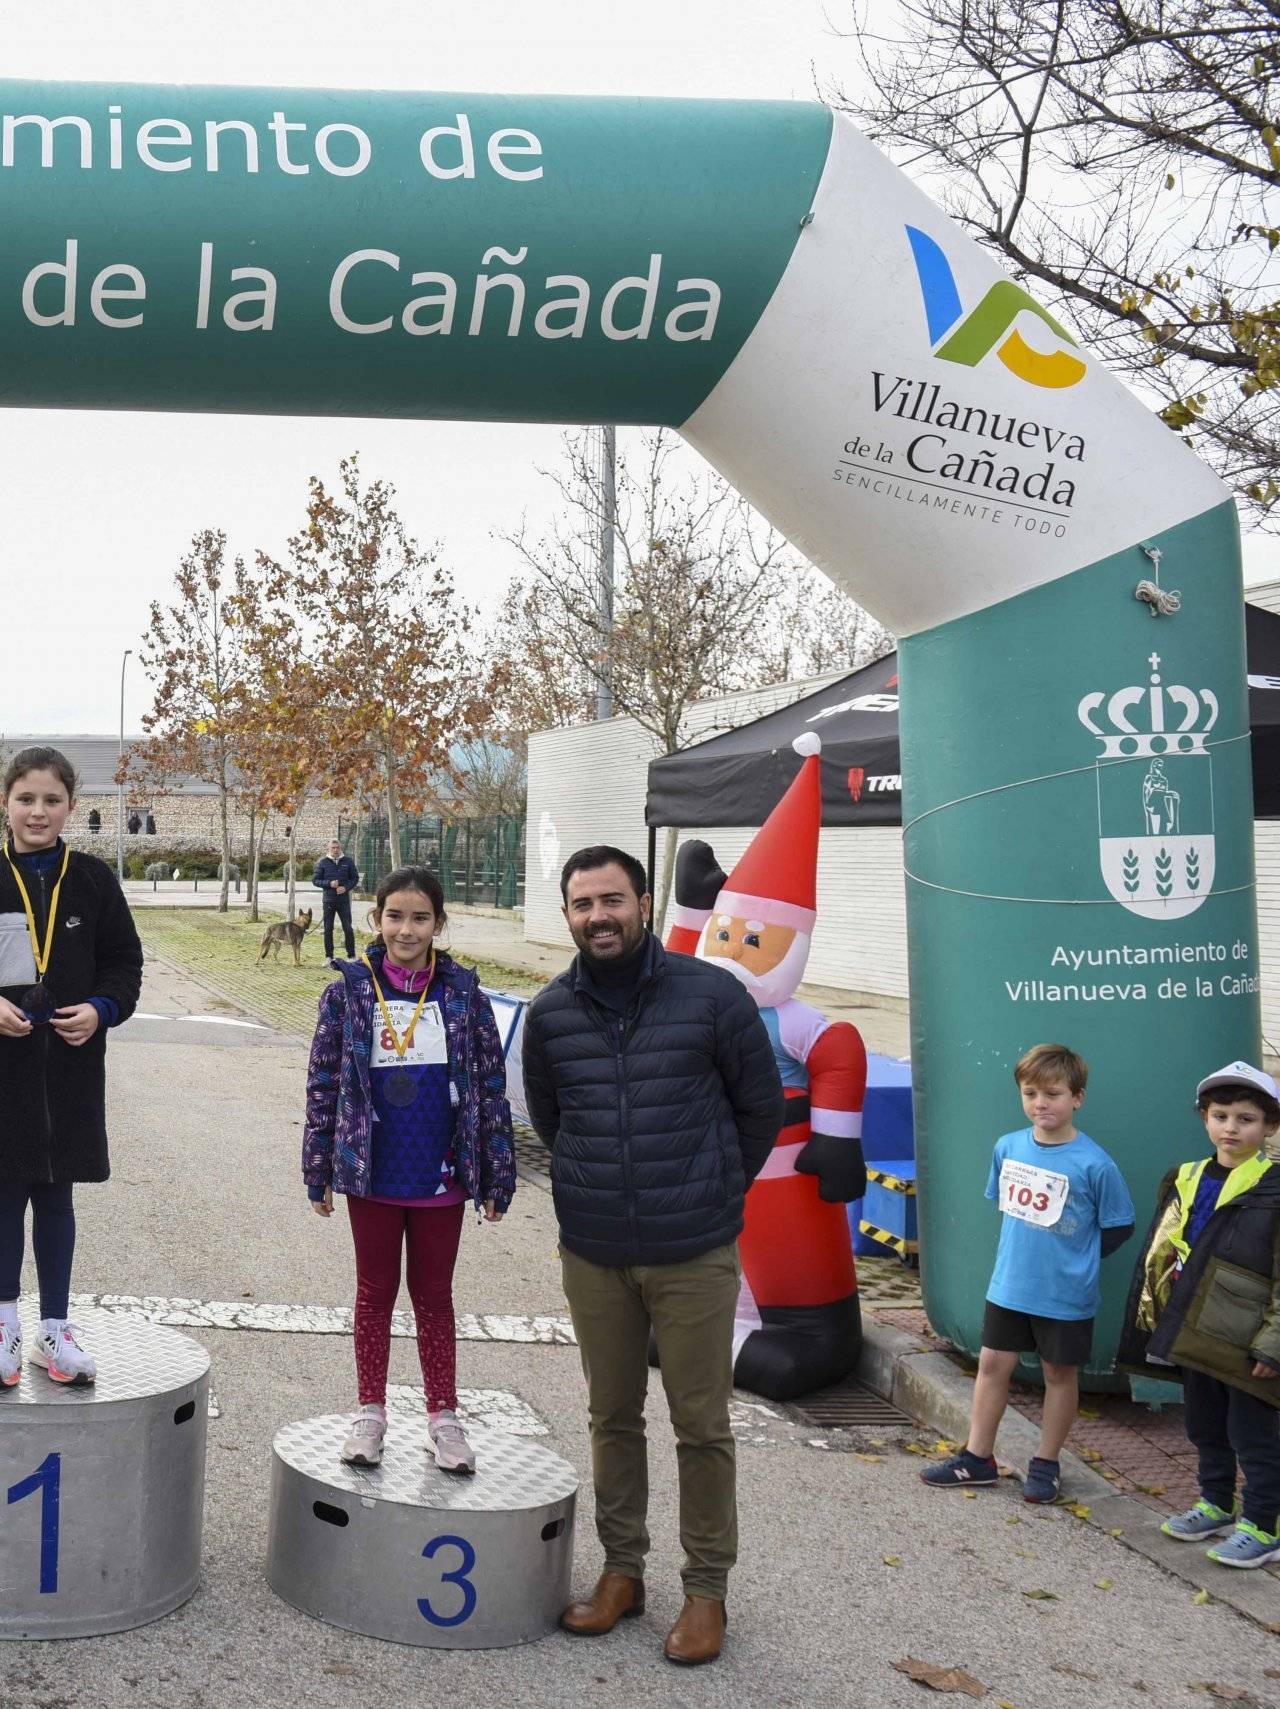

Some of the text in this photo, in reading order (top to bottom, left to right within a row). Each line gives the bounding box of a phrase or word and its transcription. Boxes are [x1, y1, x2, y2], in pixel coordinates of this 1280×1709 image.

[420, 113, 544, 182] de
[22, 239, 146, 327] de
[196, 242, 277, 331] la
[329, 246, 721, 341] Cañada
[871, 371, 1085, 462] Villanueva
[832, 468, 1066, 538] SENCILLAMENTE TODO
[843, 434, 1076, 507] de la Cañada
[1005, 980, 1147, 1001] Villanueva
[1157, 977, 1187, 999] de
[1195, 976, 1213, 997] la
[1051, 939, 1248, 971] Ayuntamiento de
[380, 1028, 415, 1051] 81
[1008, 1183, 1050, 1212] 103
[7, 1452, 61, 1594] 1
[417, 1534, 477, 1628] 3
